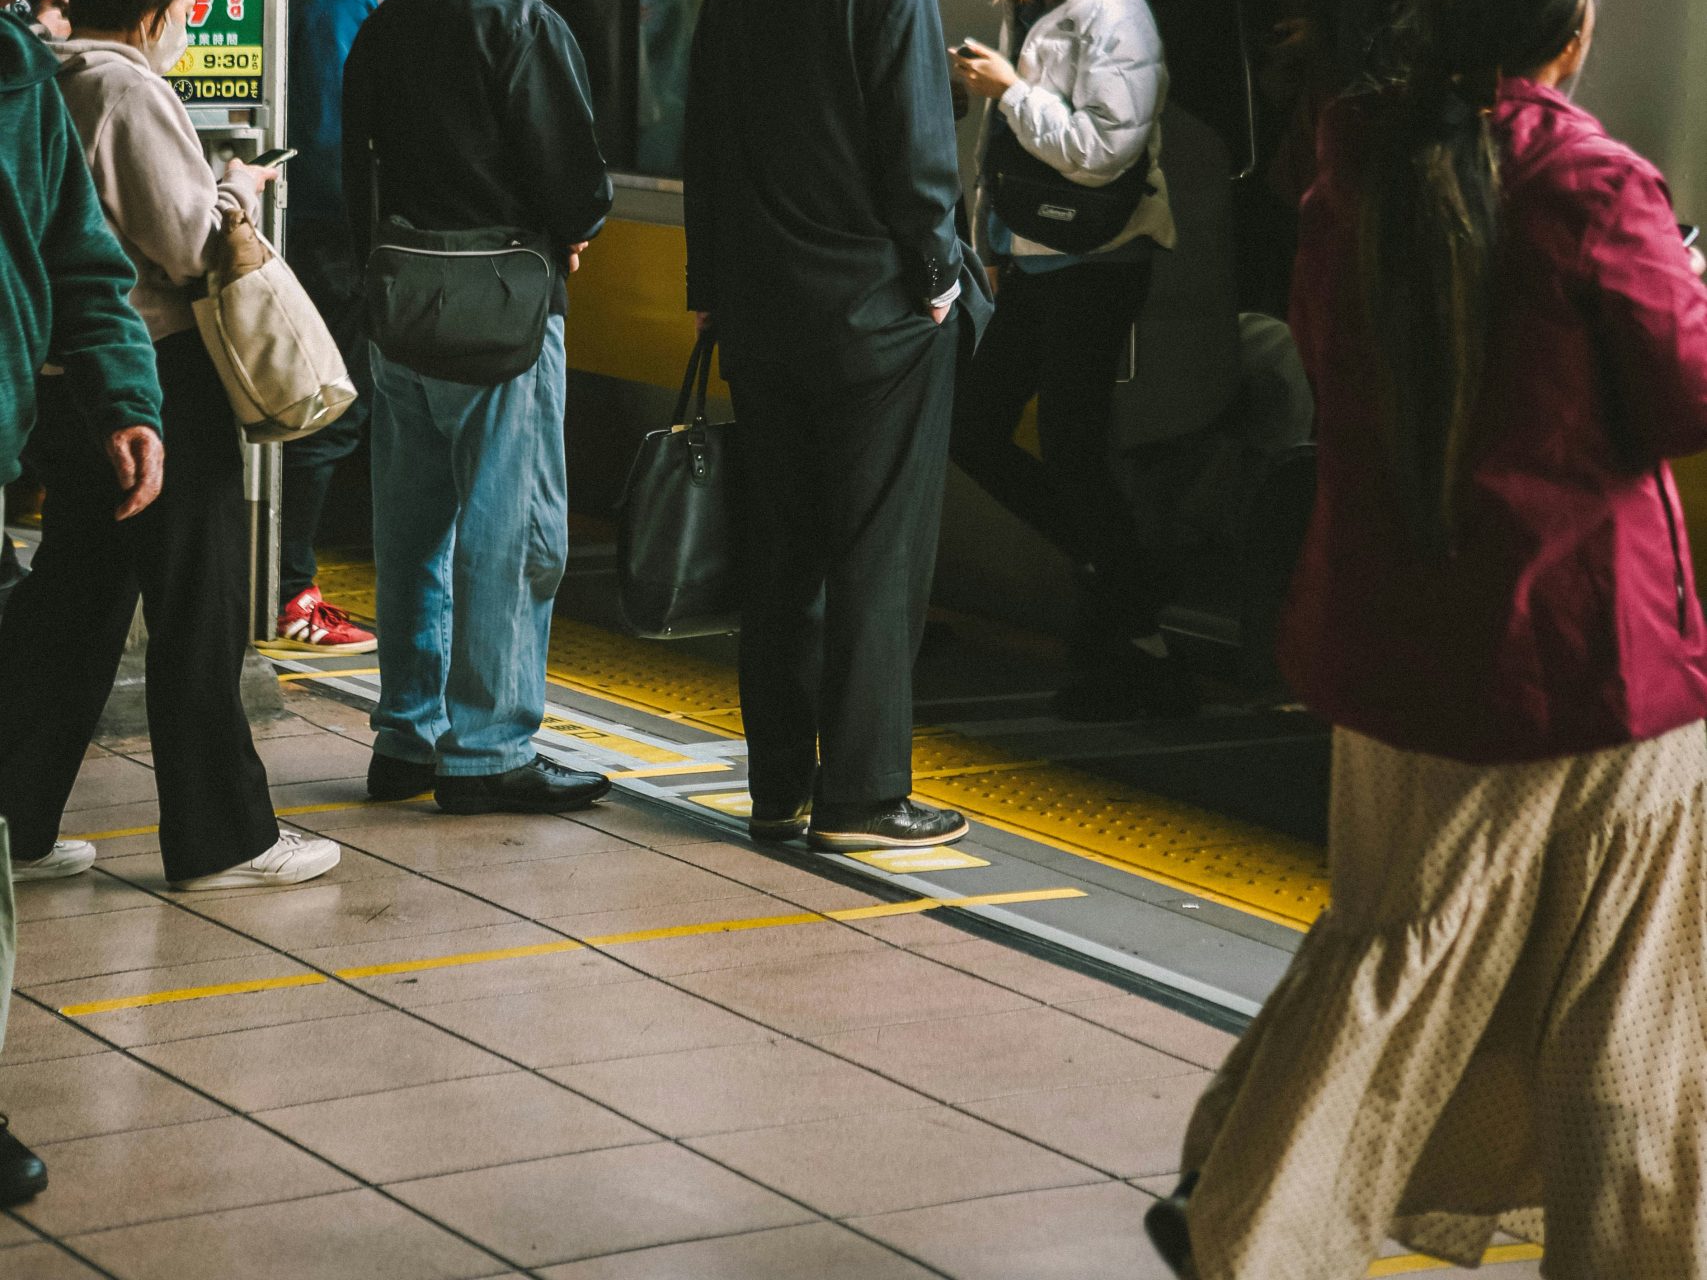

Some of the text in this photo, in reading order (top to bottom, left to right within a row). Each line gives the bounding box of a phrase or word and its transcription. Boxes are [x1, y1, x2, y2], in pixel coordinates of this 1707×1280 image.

[203, 53, 259, 70] 9:30 から
[194, 79, 259, 99] 10:00 まで
